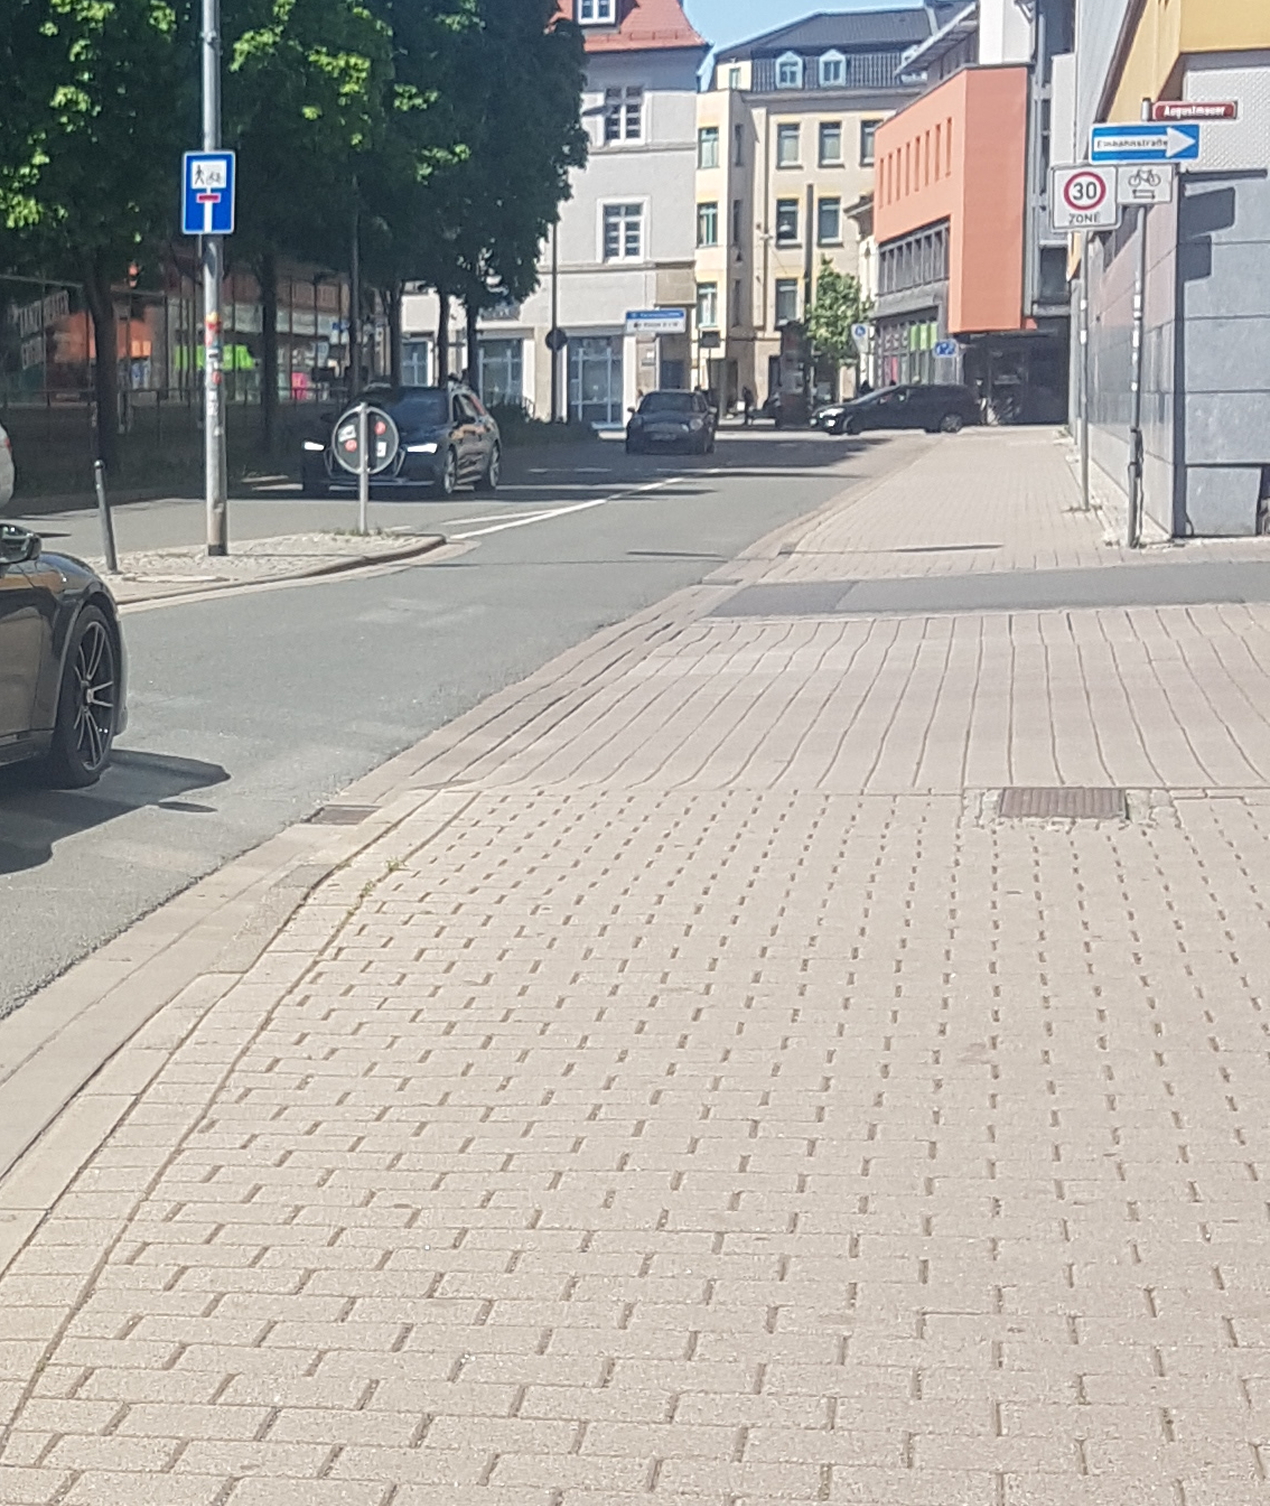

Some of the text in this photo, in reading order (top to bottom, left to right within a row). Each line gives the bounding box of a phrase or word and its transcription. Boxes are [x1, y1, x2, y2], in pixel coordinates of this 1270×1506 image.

[1097, 138, 1168, 149] Einbahnstraße
[1072, 181, 1098, 201] 30
[1069, 212, 1101, 224] ZONE
